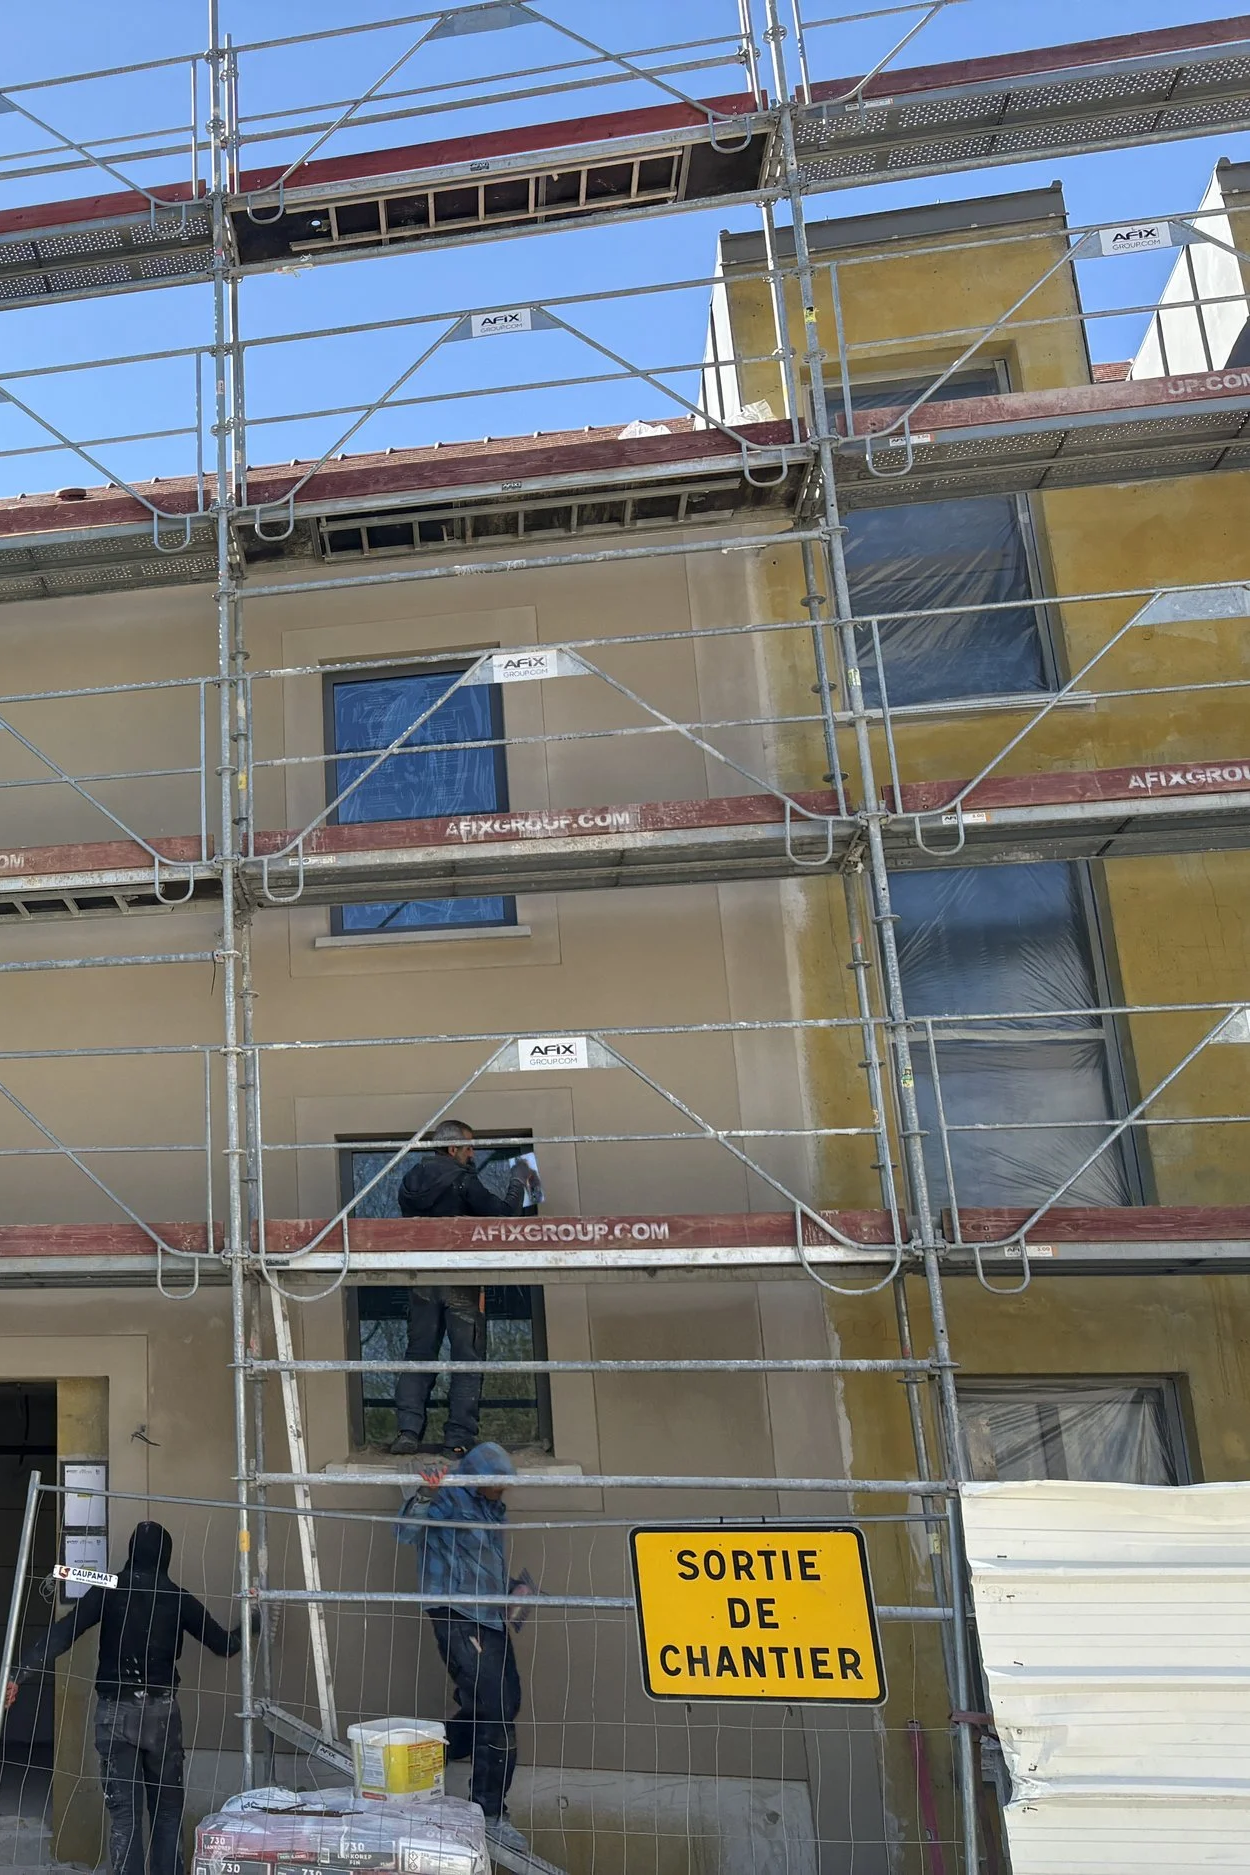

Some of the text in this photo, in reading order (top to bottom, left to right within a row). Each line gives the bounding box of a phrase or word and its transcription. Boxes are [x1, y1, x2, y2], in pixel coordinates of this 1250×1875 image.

[446, 811, 630, 836] AFIXGROUP.COM
[471, 1222, 670, 1242] AFIXGROUP.COM
[72, 1568, 113, 1582] CAUPAMAT
[677, 1550, 821, 1581] SORTIE
[727, 1598, 779, 1629] DE
[659, 1645, 864, 1680] CHANTIER
[210, 1836, 226, 1845] 730
[343, 1842, 365, 1852] 730
[221, 1863, 241, 1874] 730
